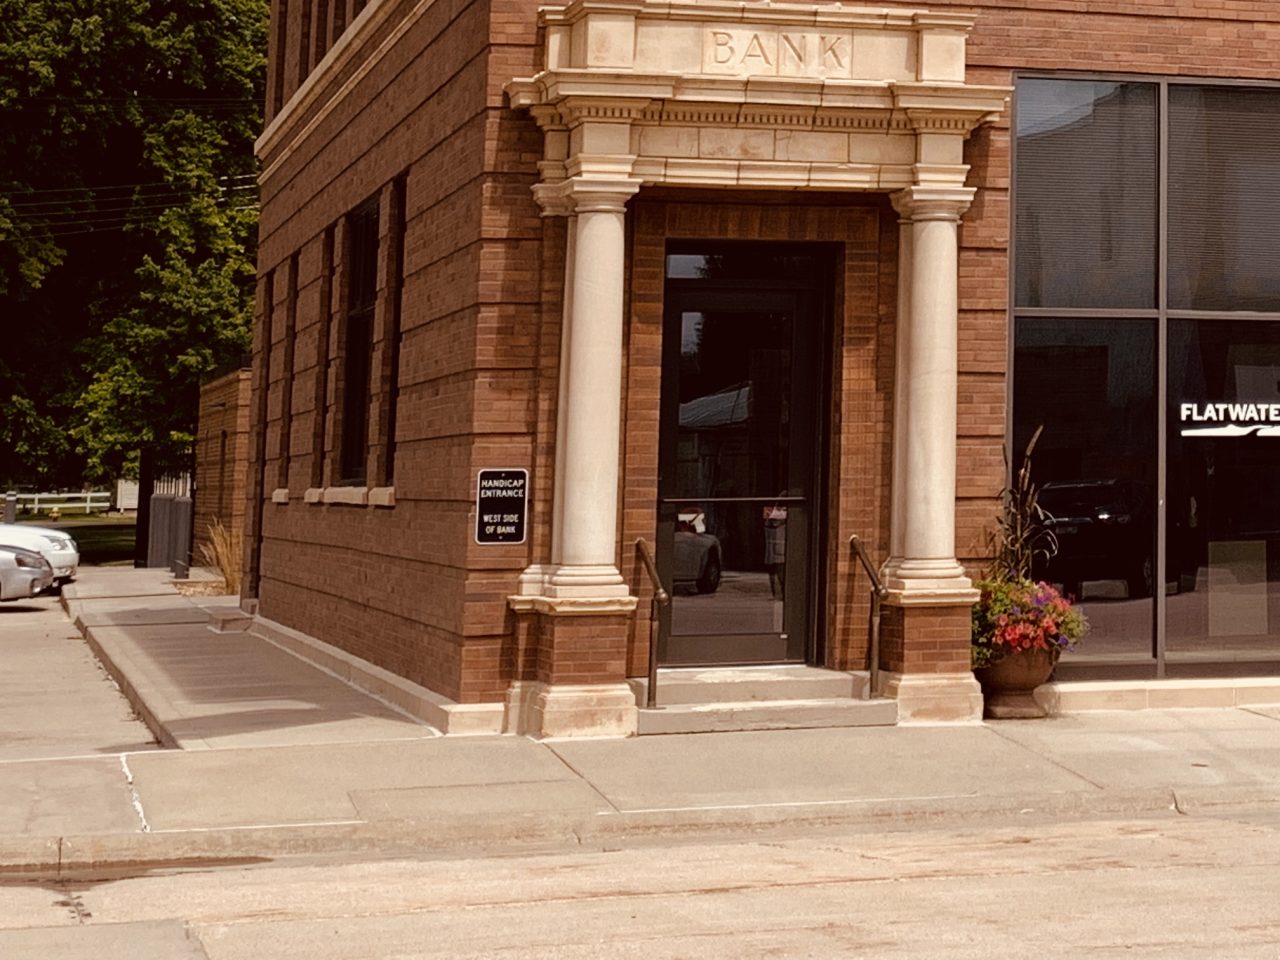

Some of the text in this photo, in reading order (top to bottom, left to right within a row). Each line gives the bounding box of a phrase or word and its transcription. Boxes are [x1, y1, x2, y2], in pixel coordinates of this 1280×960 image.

[711, 30, 846, 69] BANK
[481, 479, 525, 488] HANDICAP
[480, 489, 524, 498] ENTRANCE
[483, 514, 519, 522] WEST SIDE
[485, 525, 516, 534] OF BANK
